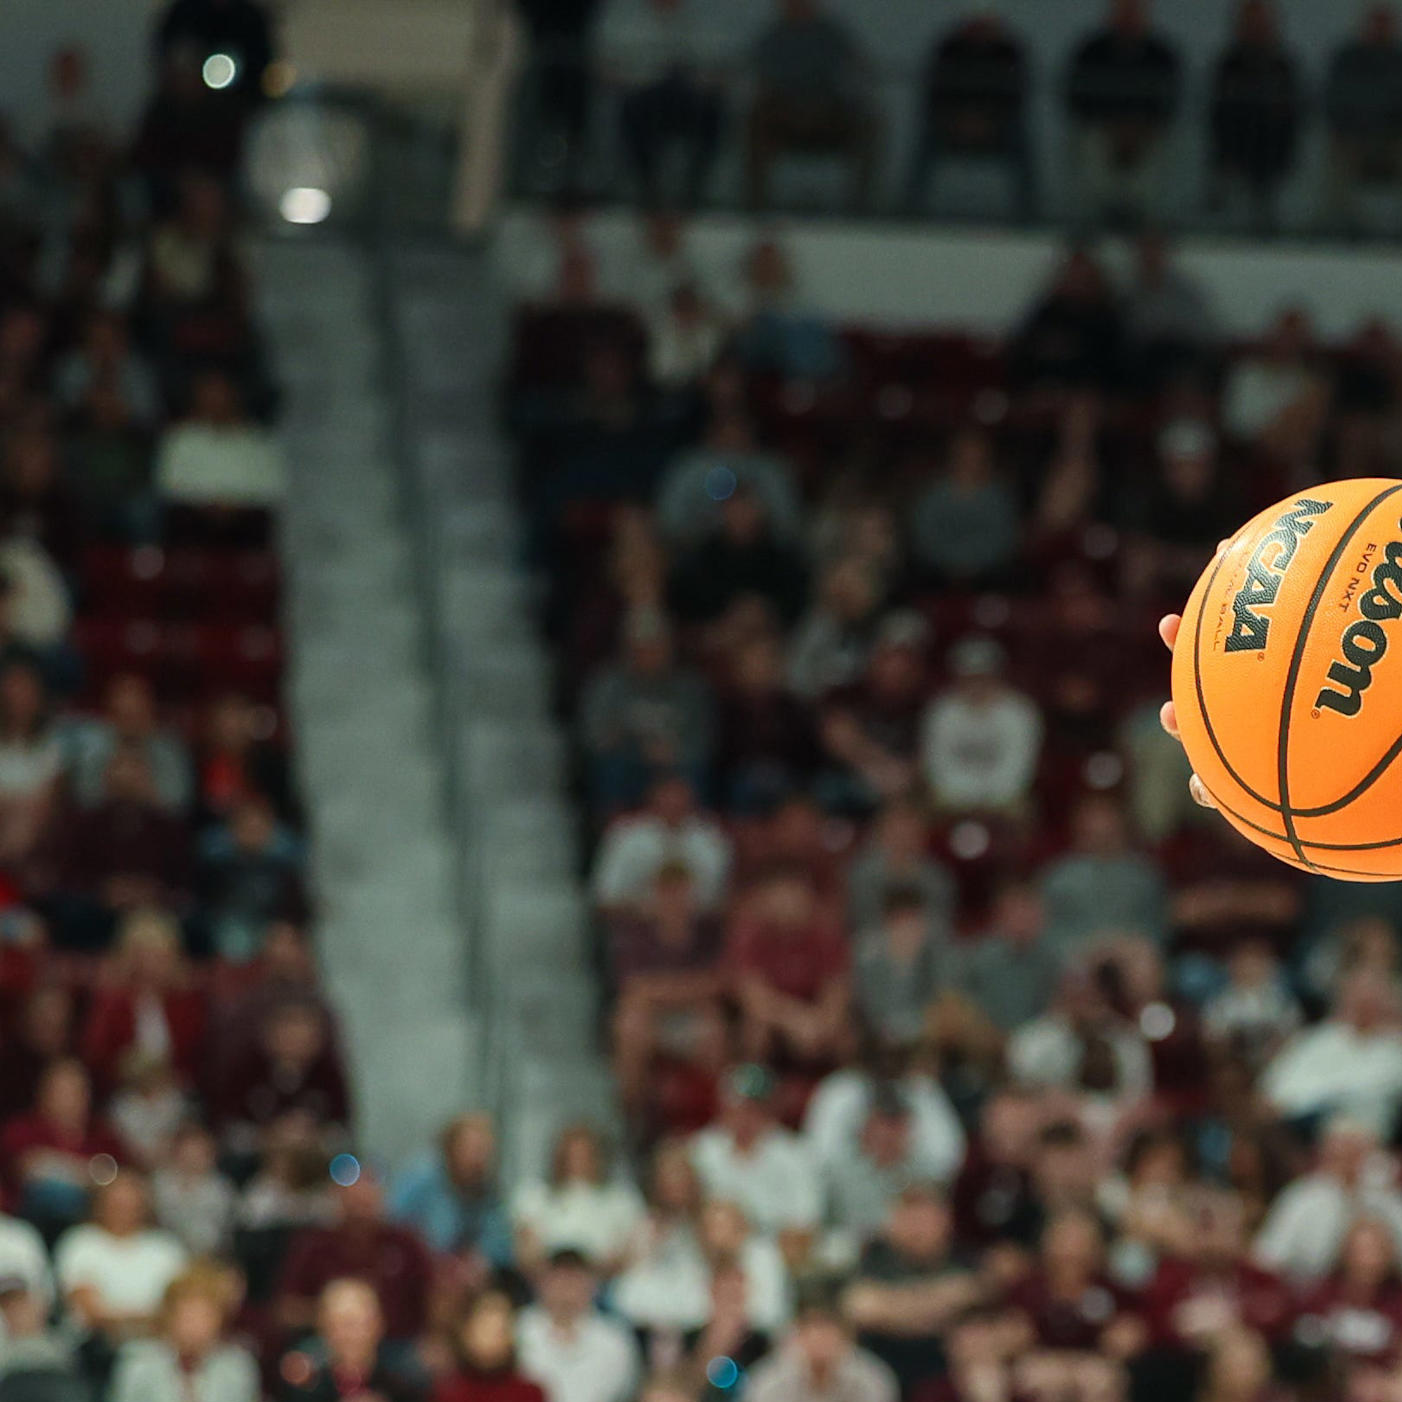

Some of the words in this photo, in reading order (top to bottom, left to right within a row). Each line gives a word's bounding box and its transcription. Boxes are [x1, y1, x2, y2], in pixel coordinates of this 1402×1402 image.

[1224, 498, 1334, 653] NCAA
[1356, 542, 1377, 574] EVO
[1338, 577, 1361, 613] NXT
